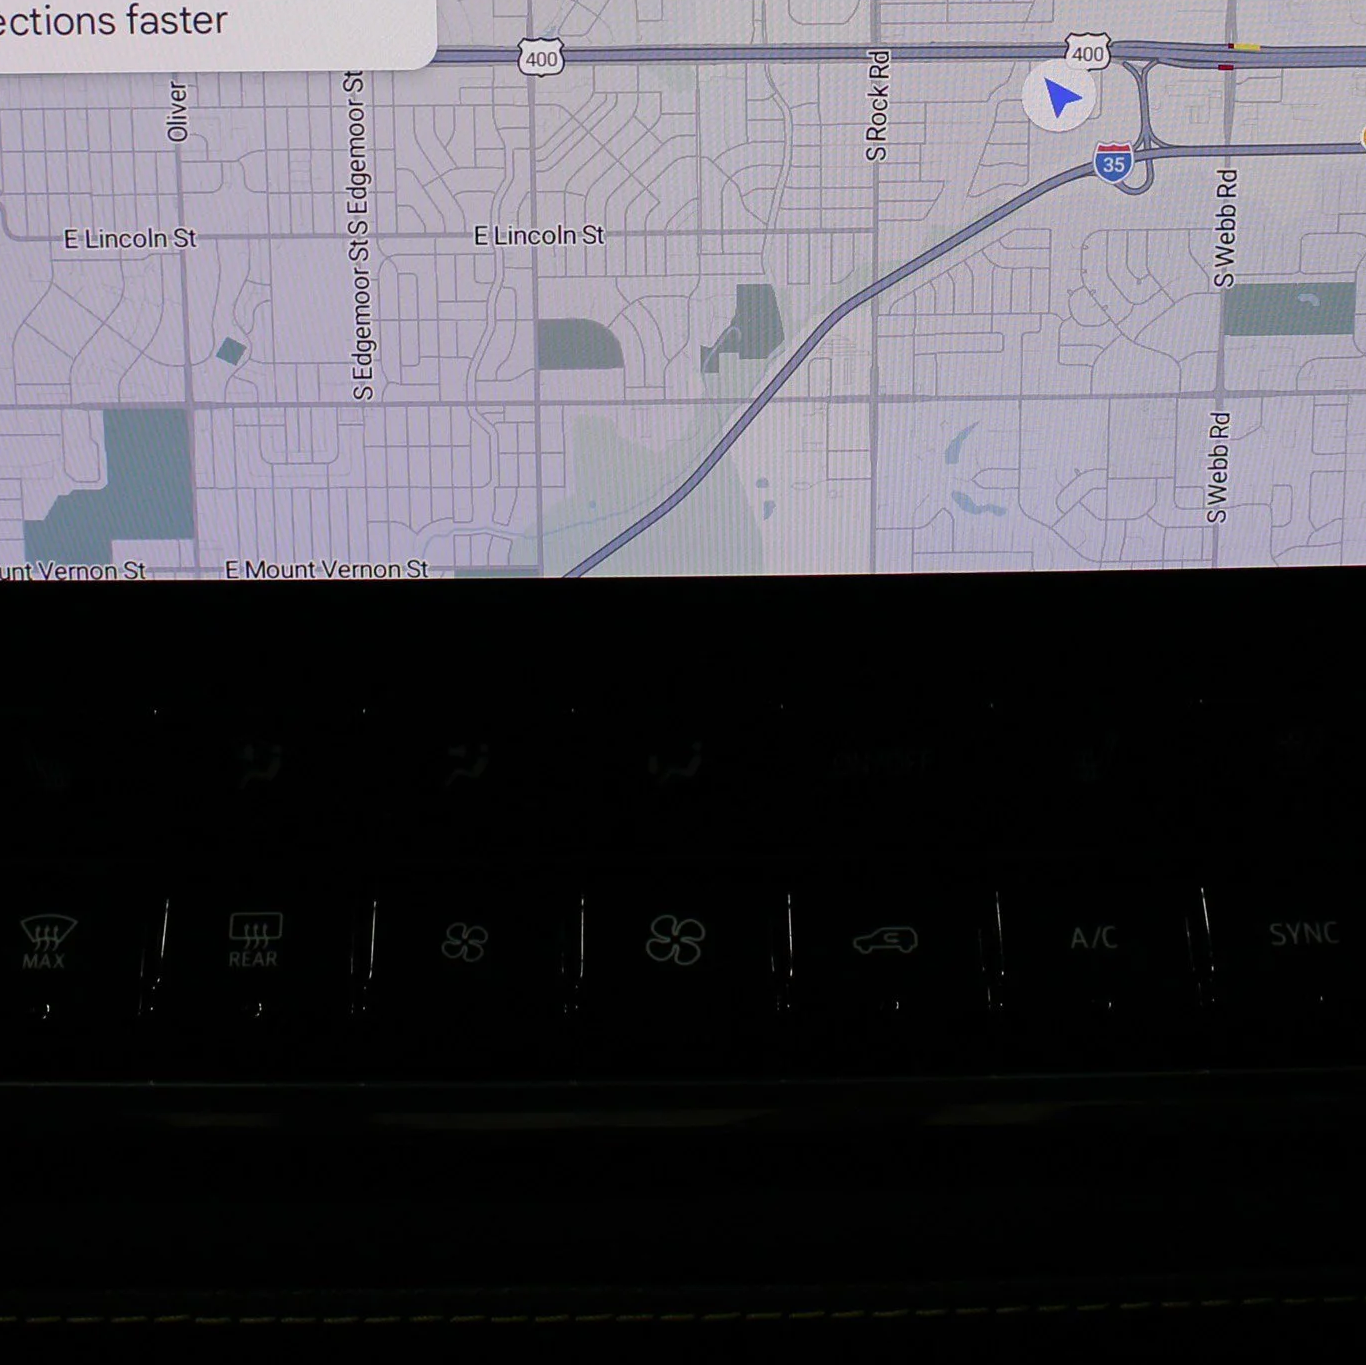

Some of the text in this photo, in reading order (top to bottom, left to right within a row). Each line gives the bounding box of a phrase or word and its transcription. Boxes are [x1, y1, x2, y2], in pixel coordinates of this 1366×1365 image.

[126, 2, 228, 35] faster
[525, 52, 557, 68] 400
[1072, 45, 1103, 62] 400
[166, 81, 188, 142] Oliver
[865, 51, 890, 161] S Rock Rd
[342, 70, 372, 235] S Edgemoor St
[1103, 157, 1126, 173] 35
[64, 227, 196, 249] E Lincoln St
[474, 224, 604, 246] E Lincoln St
[1213, 169, 1238, 287] S Webb Rd
[348, 239, 377, 400] S Edgemoor St
[1206, 412, 1231, 523] S Webb Rd
[37, 562, 119, 581] Vernon
[124, 561, 146, 580] St
[225, 558, 429, 579] E Mount Vernon St
[1069, 925, 1119, 950] A/C
[1269, 921, 1340, 947] SYNC
[21, 952, 66, 970] MAX
[228, 950, 279, 968] REAR
